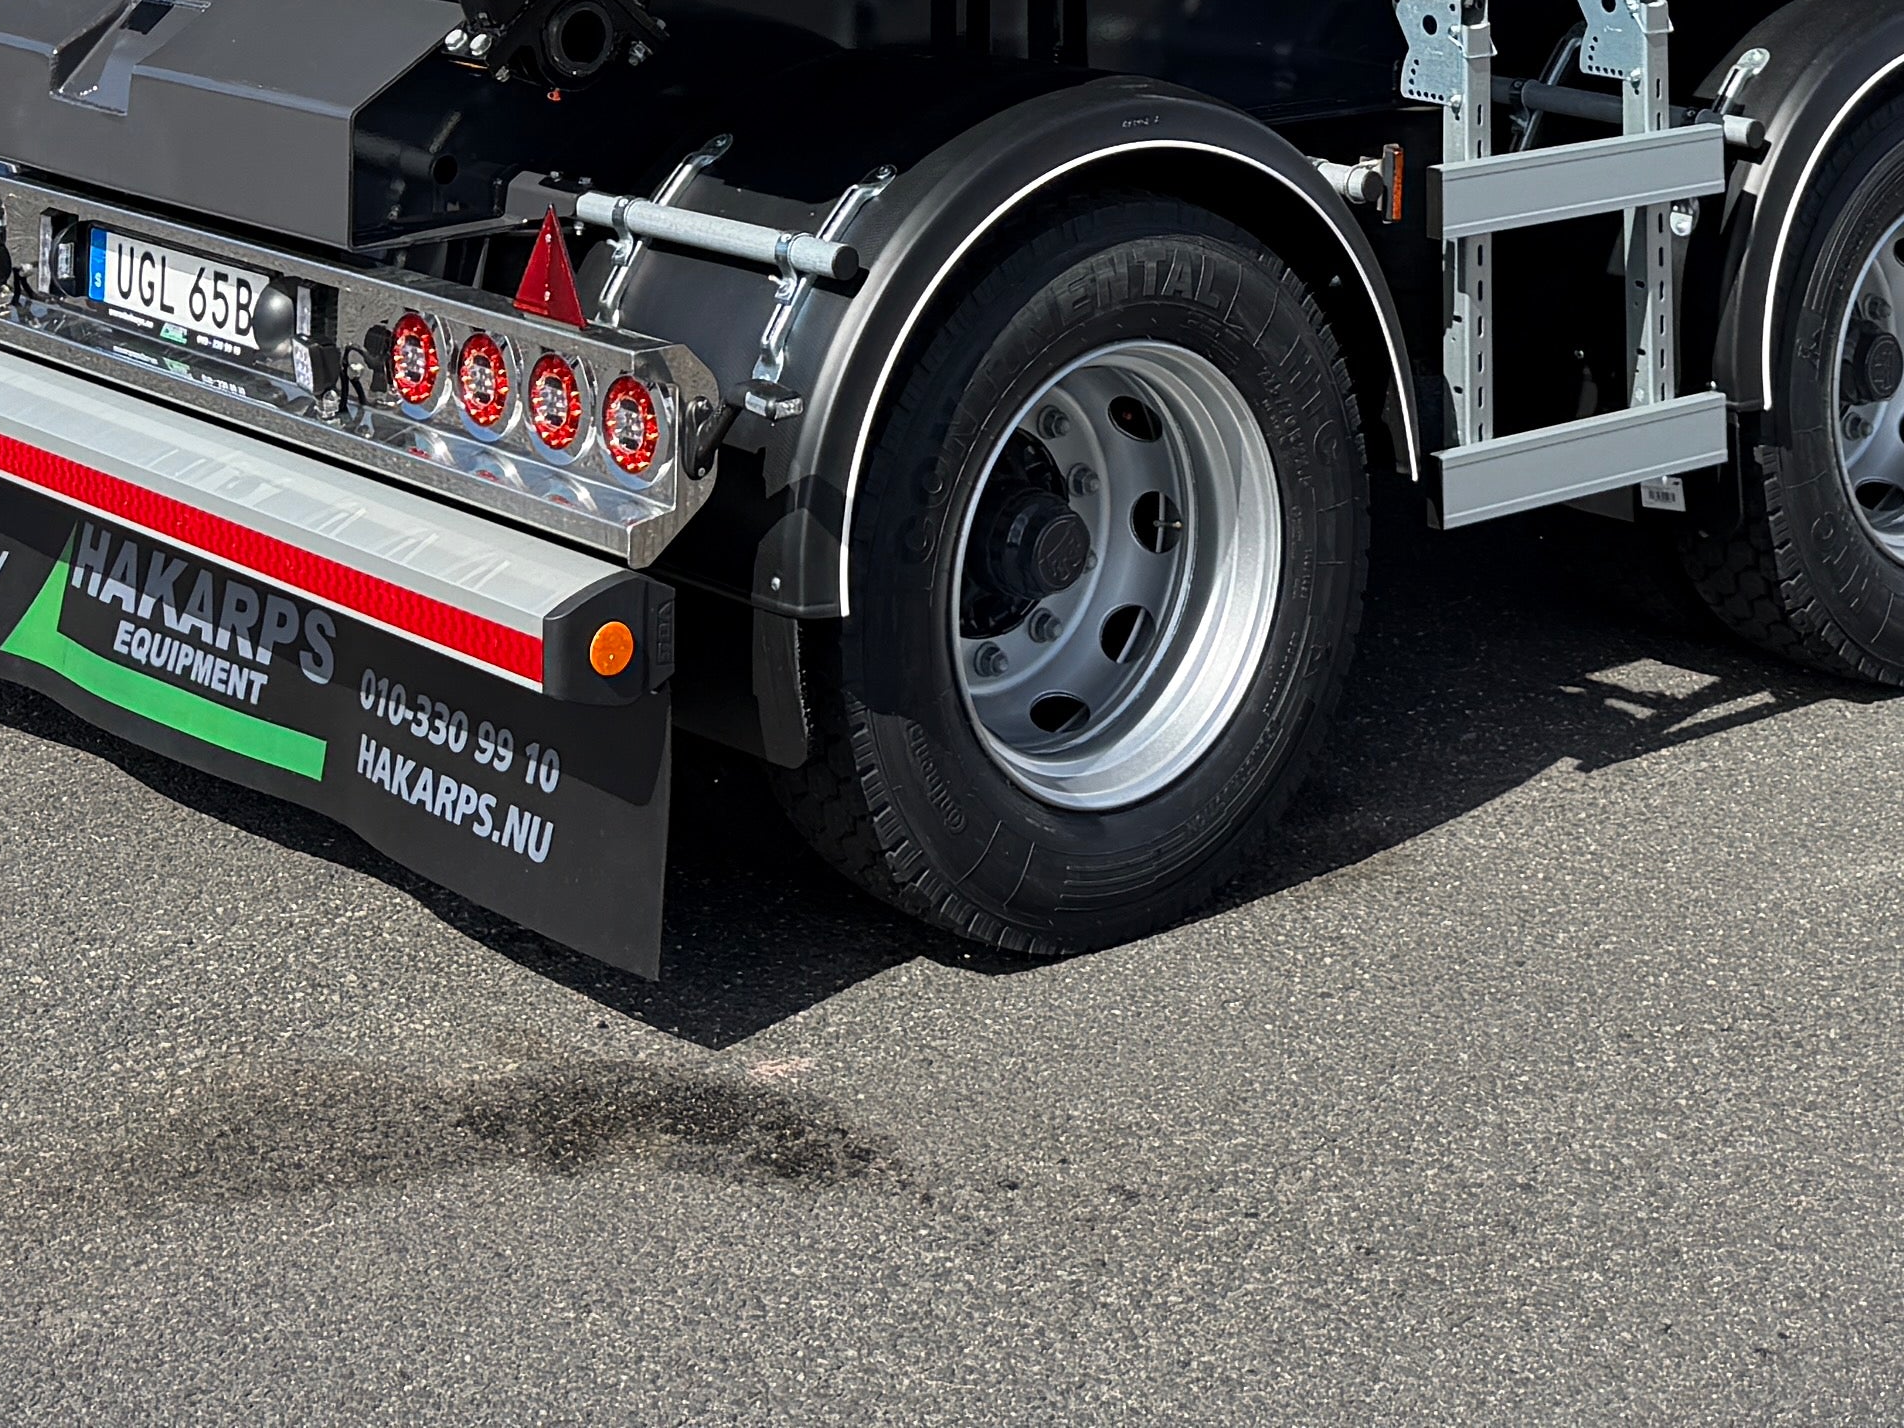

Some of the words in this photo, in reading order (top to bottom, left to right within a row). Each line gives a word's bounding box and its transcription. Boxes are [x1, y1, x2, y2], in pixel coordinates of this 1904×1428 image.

[117, 243, 175, 315] UGL
[189, 266, 254, 337] 65B
[71, 521, 336, 685] HAKARPS
[113, 620, 268, 705] EQUIPMENT
[360, 668, 469, 753] 010-330
[474, 721, 514, 772] 99
[525, 742, 560, 793] 10
[357, 733, 554, 863] HAKARPS.NU
